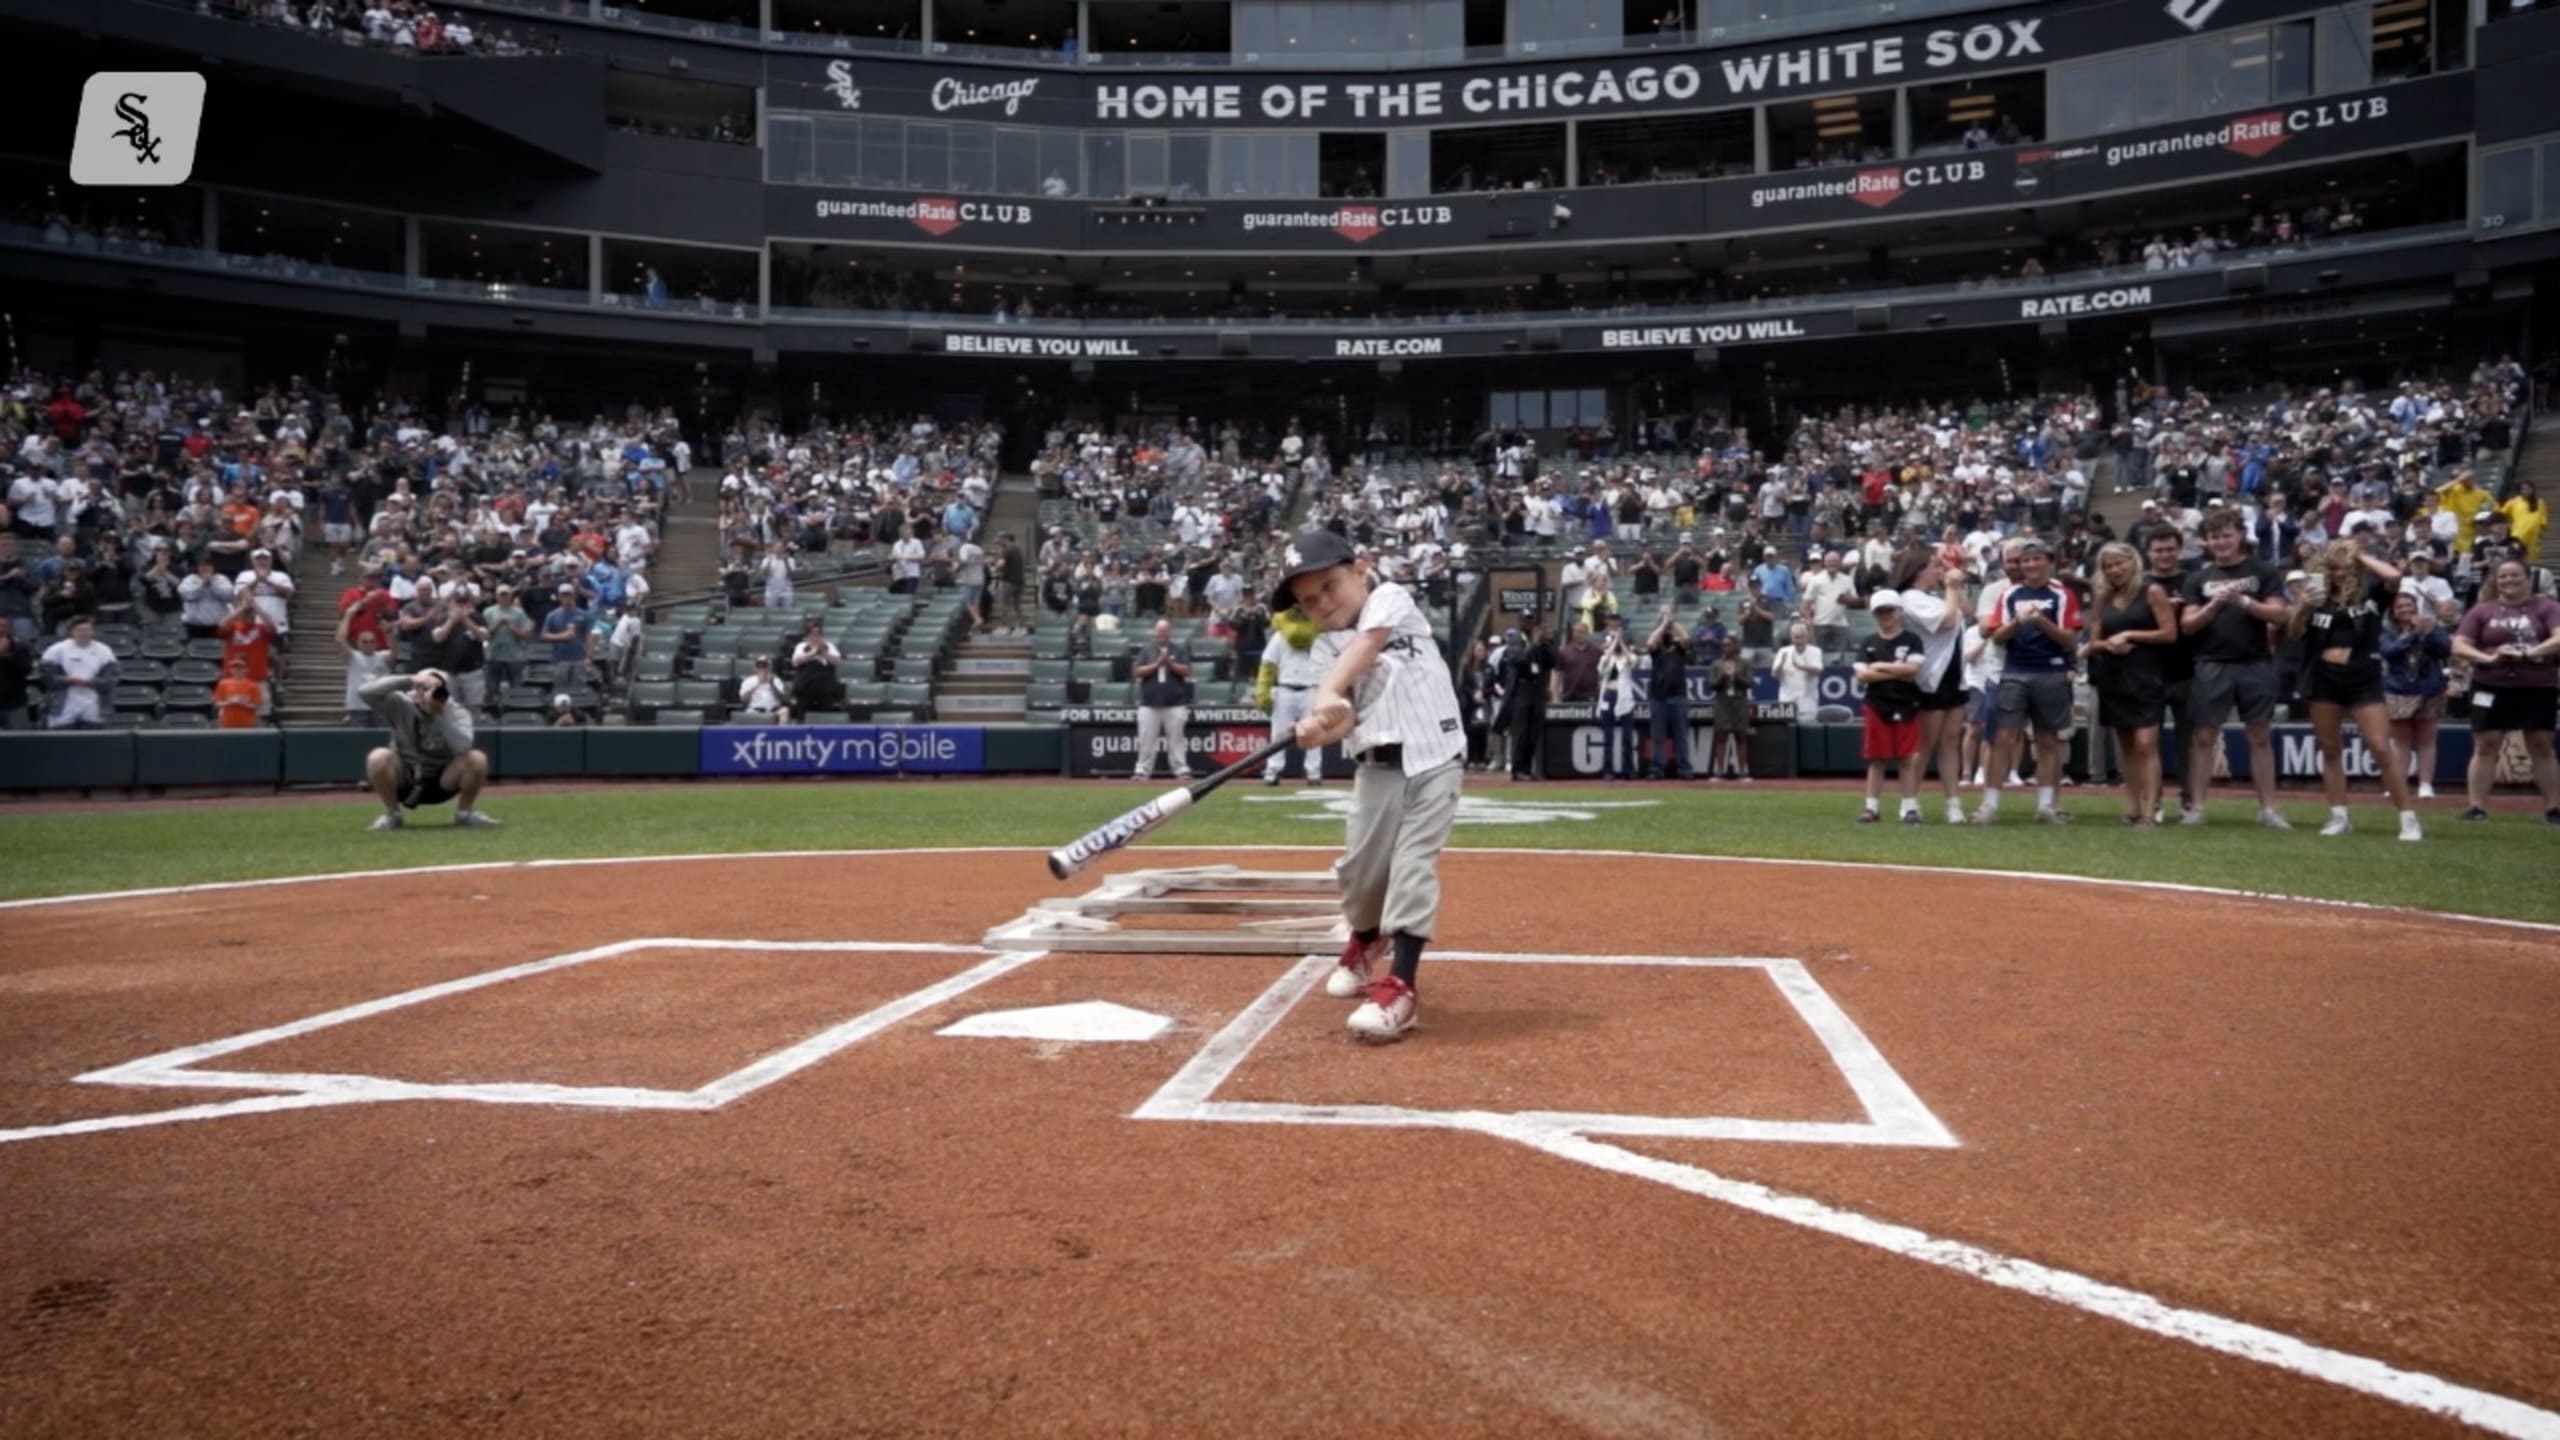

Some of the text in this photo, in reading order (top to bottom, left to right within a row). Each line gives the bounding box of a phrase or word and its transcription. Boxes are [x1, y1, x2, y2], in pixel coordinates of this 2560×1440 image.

[1097, 19, 2044, 118] HOME OF THE CHICAGO WHITE SOX
[931, 77, 1039, 116] Chicago
[2107, 126, 2230, 165] guaranteed
[2233, 119, 2282, 142] Rate
[2288, 97, 2388, 131] CLUB
[1752, 178, 1856, 207] guaranteed
[1858, 175, 1900, 192] Rate
[1904, 161, 1985, 186] CLUB
[817, 200, 1032, 223] guaranteed Rate CLUB
[1243, 207, 1452, 230] guaranteed Rate CLUB
[2021, 286, 2151, 317] RATE.COM
[946, 335, 1139, 355] BELIEVE YOU WILL.
[1602, 319, 1805, 347] BELIEVE YOU WILL.
[1336, 338, 1442, 355] RATE.COM
[1061, 709, 1090, 721] FOR
[1093, 709, 1139, 721] TICKET
[1757, 703, 1795, 719] Field
[732, 732, 836, 768] xfinity
[1219, 731, 1268, 751] Rate
